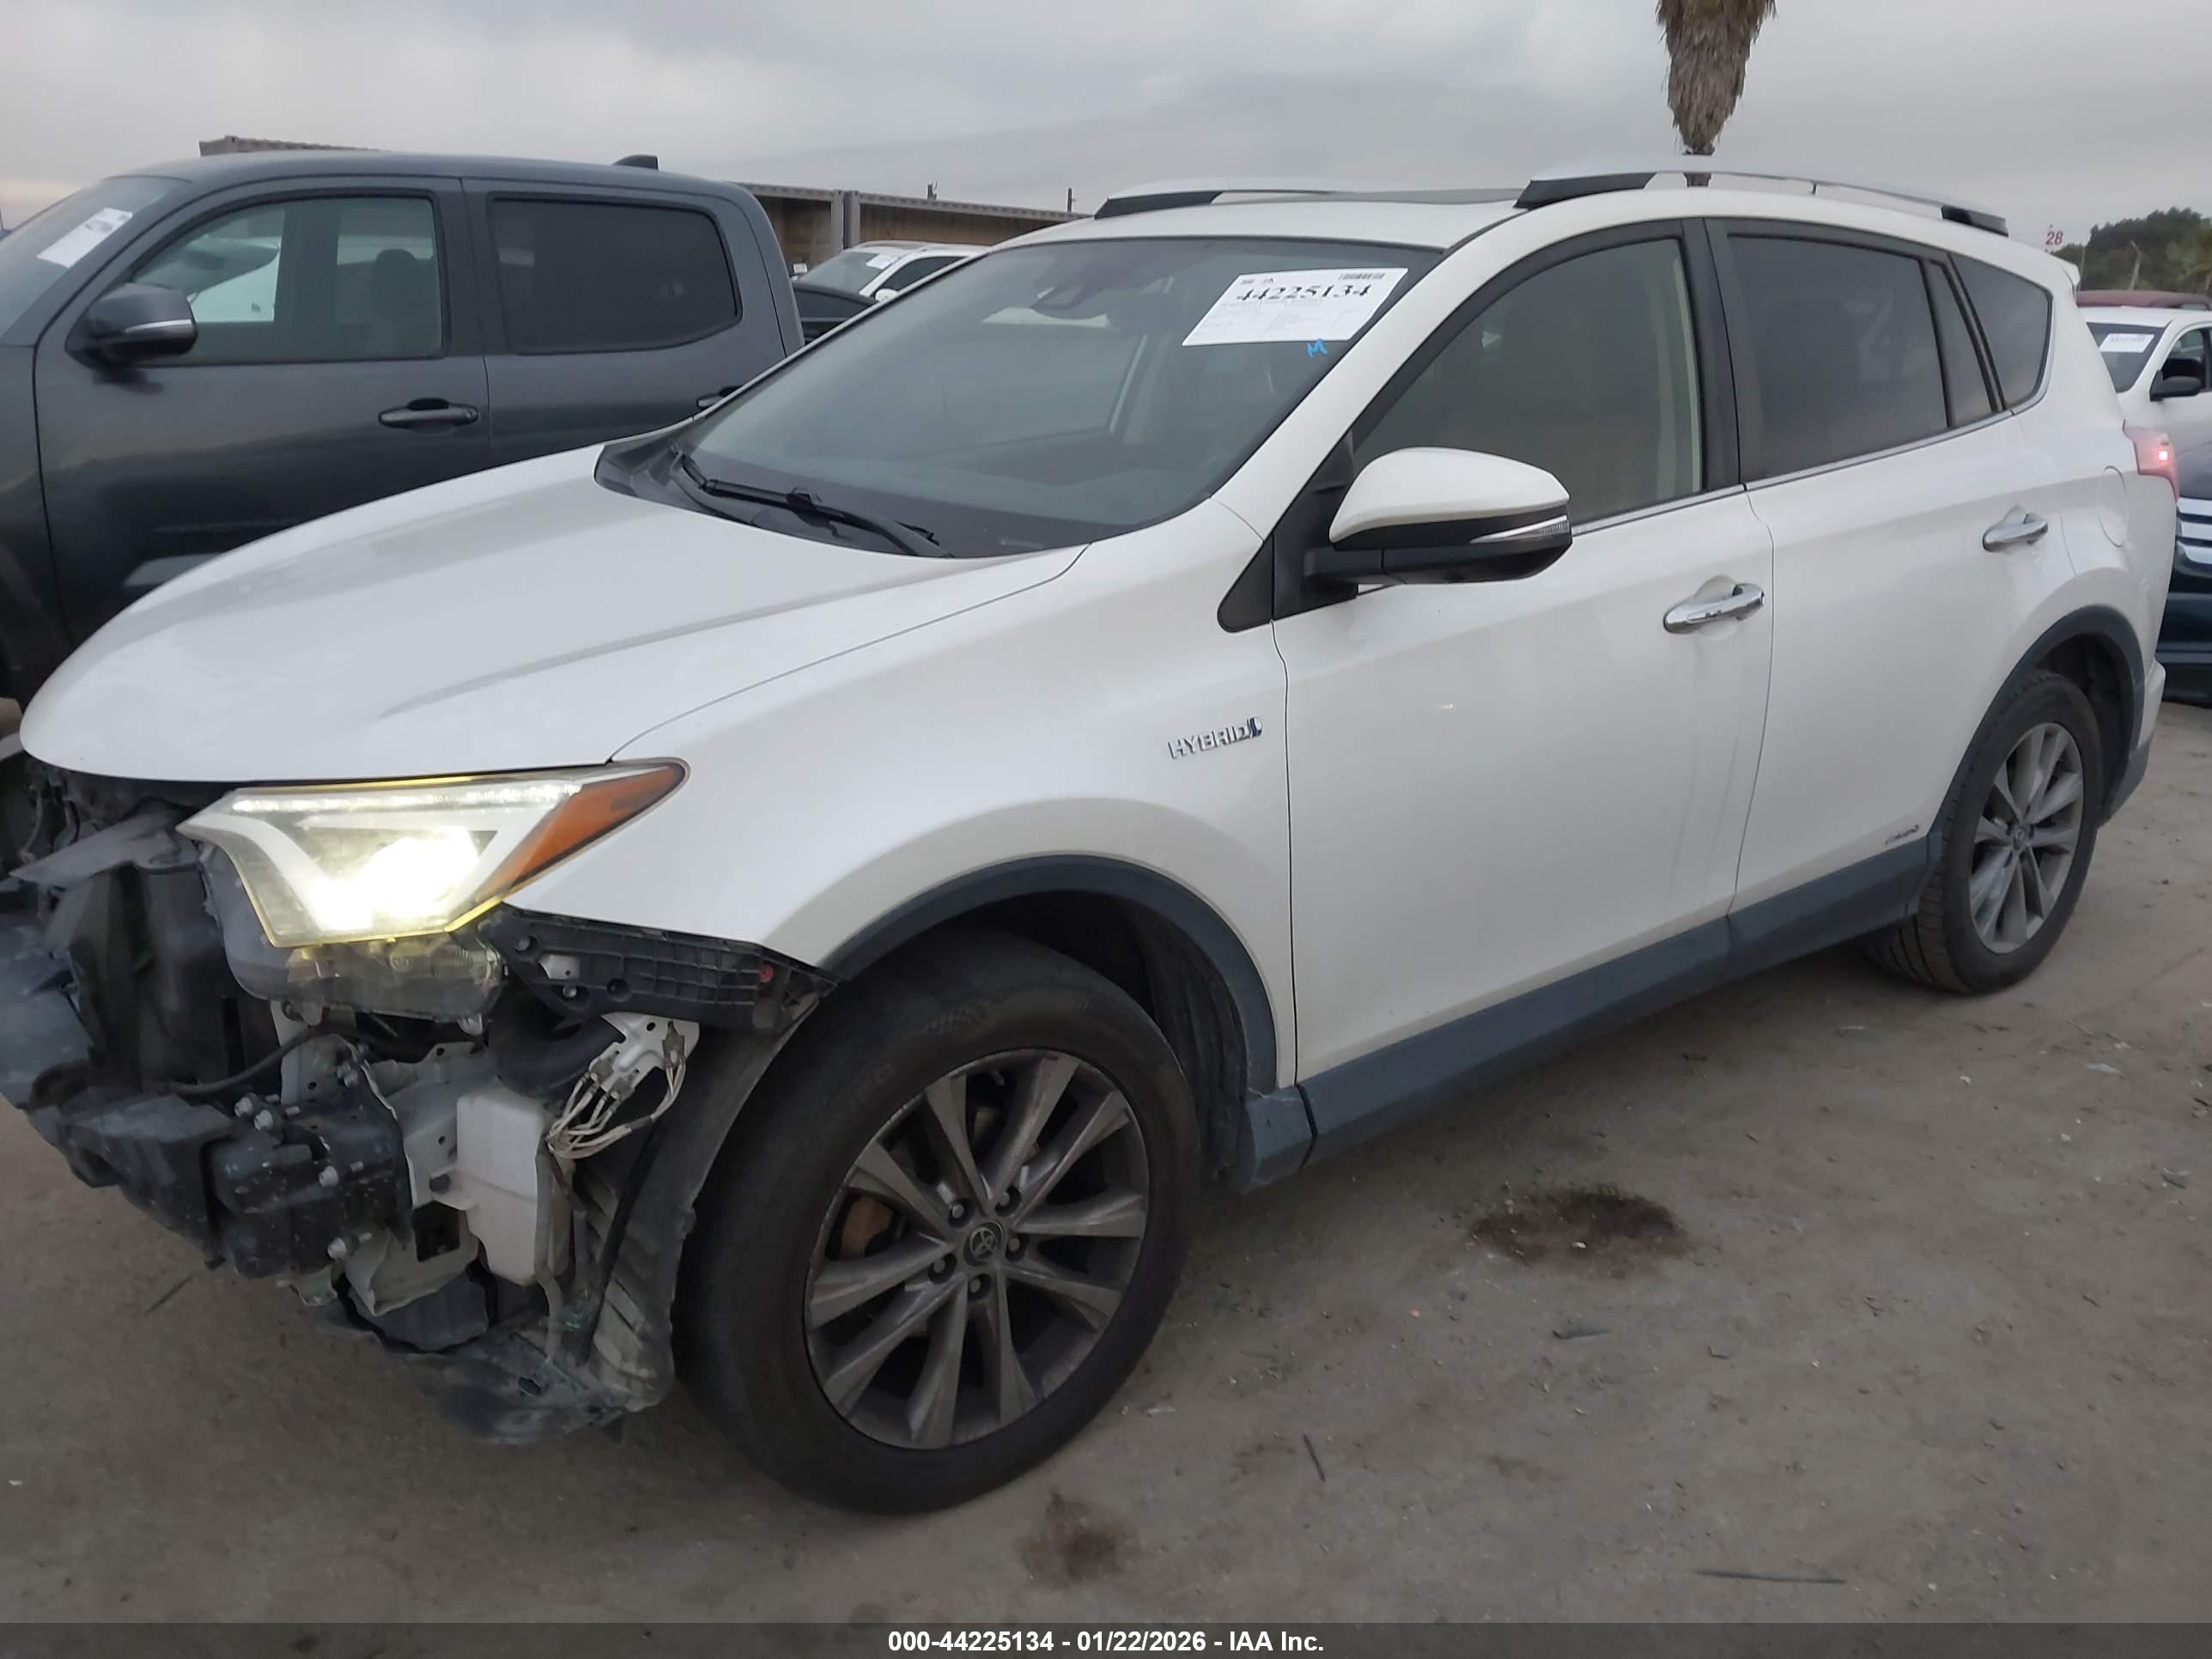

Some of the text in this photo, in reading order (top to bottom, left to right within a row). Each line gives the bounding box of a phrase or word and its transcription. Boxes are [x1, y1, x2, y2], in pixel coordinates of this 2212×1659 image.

[2045, 230, 2063, 246] 28
[1237, 284, 1372, 301] 44225134
[1168, 725, 1250, 759] HYBRID
